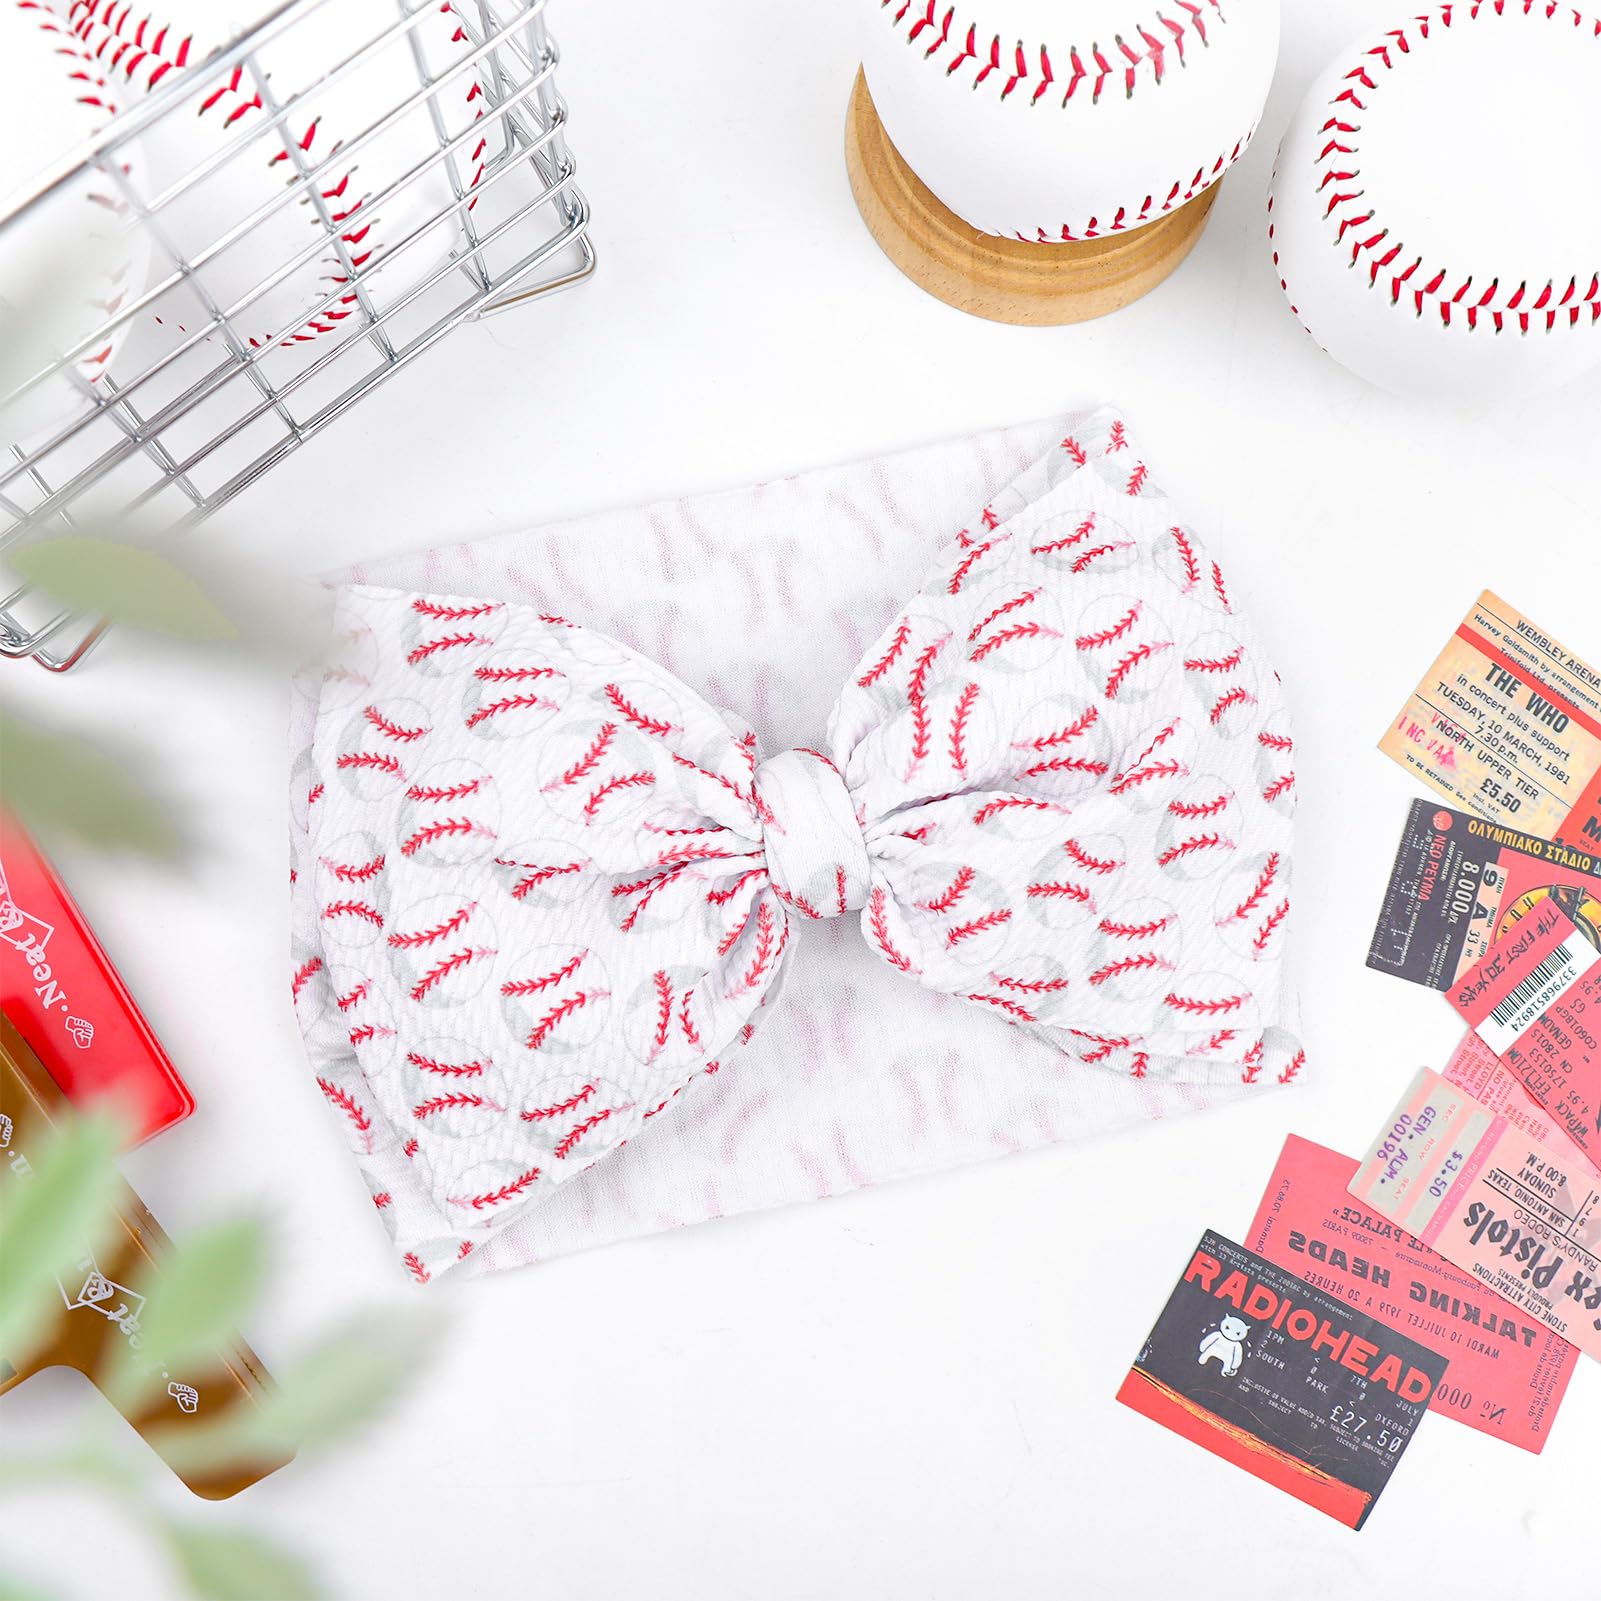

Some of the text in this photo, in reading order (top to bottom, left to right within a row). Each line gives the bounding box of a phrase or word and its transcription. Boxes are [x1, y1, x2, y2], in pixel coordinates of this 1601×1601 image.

[1474, 614, 1598, 708] Harvey Goldsmith by arrangement
[1516, 621, 1601, 688] WEMBLEY ARENA
[1482, 663, 1570, 734] THE WHO
[1531, 671, 1548, 686] Ltd.
[1548, 683, 1581, 710] presents
[1438, 682, 1485, 724] TUESDAY,
[1487, 719, 1503, 735] 10
[1503, 731, 1542, 766] MARCH,
[1544, 762, 1571, 784] 1981
[1457, 676, 1570, 761] in concert plus support
[1435, 720, 1474, 752] NORTH
[1476, 750, 1512, 779] UPPER
[1513, 778, 1539, 799] TIER
[1475, 725, 1499, 747] 7.30
[1497, 745, 1517, 763] p.m.
[1424, 768, 1454, 792] RETAINED
[1480, 778, 1520, 812] £5.50
[1488, 803, 1500, 814] VAT
[1429, 833, 1446, 858] ΝΕΟ
[1467, 821, 1543, 854] ΟΛΥΜΠΙΑΚΟ
[1544, 845, 1591, 872] ΣΤΑΔΙΟ
[1418, 861, 1438, 902] ΡΕΥΜΑ
[1451, 862, 1479, 912] 8.000
[1481, 868, 1498, 888] 9
[1467, 930, 1480, 944] 33
[1537, 908, 1560, 937] THE
[1506, 930, 1535, 964] FIRST
[12, 934, 65, 1009] Neat
[1511, 967, 1576, 1031] 337968518924
[1531, 1029, 1574, 1074] CN 28015
[1537, 1012, 1573, 1051] GENADM
[1473, 1061, 1493, 1090] LLOYD
[1491, 1069, 1504, 1084] NO
[1529, 1048, 1588, 1114] 4.95 1750153
[1377, 1114, 1411, 1160] 00196
[1408, 1106, 1436, 1140] GEN.
[1429, 1152, 1462, 1197] $3.50
[1516, 1165, 1556, 1198] SUNDAY
[1526, 1152, 1568, 1187] 8:00 P.M.
[1488, 1169, 1566, 1229] SAN ANTONIO, TEXAS
[1465, 1203, 1562, 1288] Pistols
[1514, 1206, 1598, 1272] RANDY'S RODEO
[1216, 1243, 1249, 1265] CONCERTS
[1249, 1260, 1263, 1272] and
[1314, 1297, 1352, 1320] arrangement
[1473, 1263, 1523, 1302] ATTRACTIONS
[1496, 1267, 1526, 1292] PRESENTS
[1526, 1287, 1554, 1310] PROUDLY
[1183, 1254, 1435, 1402] RADIOHEAD
[1523, 1299, 1542, 1315] CITY
[1541, 1309, 1567, 1333] STONE
[1256, 1350, 1409, 1436] SOUTH PARK OXFORD
[1267, 1330, 1418, 1416] 1PM 7TH JULY
[1330, 1406, 1402, 1452] £27.50
